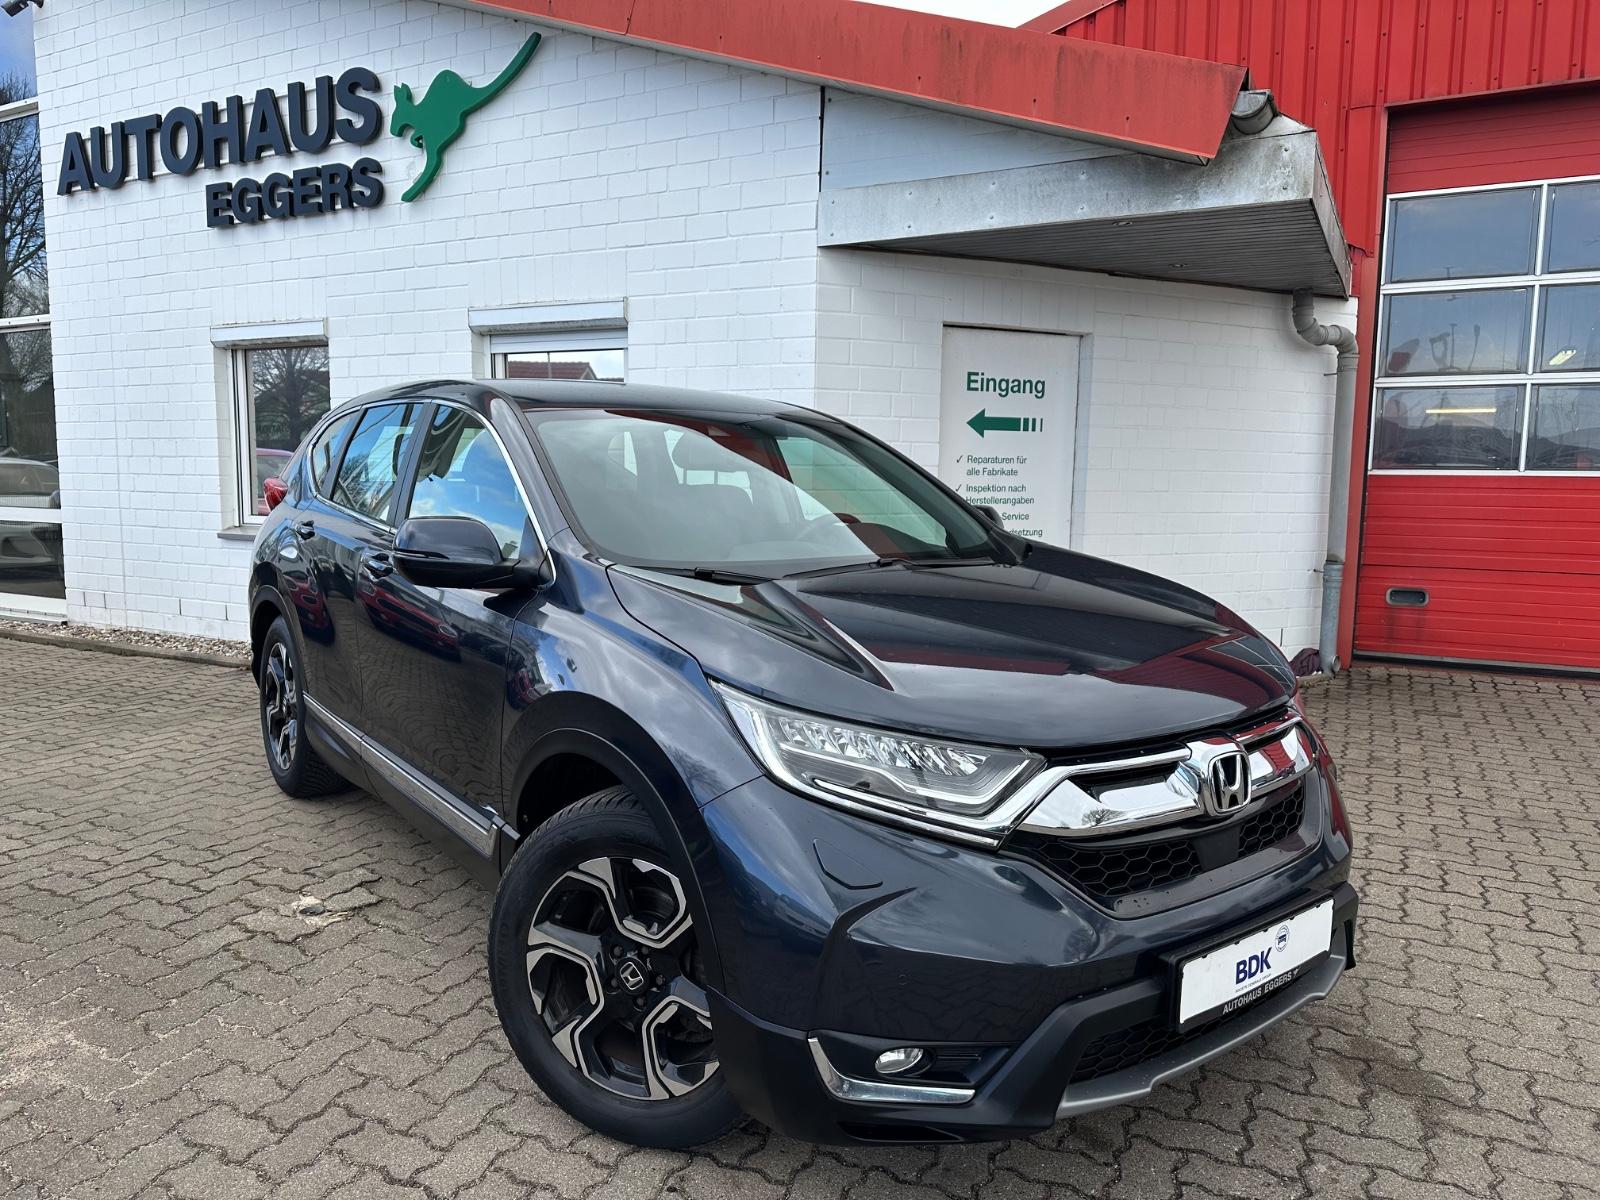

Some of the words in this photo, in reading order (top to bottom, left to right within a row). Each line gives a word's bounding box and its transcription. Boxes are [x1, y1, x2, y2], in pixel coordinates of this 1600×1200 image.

[57, 67, 383, 196] AUTOHAUS
[205, 157, 384, 228] EGGERS
[966, 372, 1045, 398] Eingang
[966, 467, 980, 476] alle
[982, 467, 1018, 476] Fabrikate
[967, 455, 1014, 465] Reparaturen
[1016, 456, 1027, 464] für
[966, 484, 1006, 493] Inspektion
[1008, 484, 1026, 492] nach
[1235, 946, 1272, 985] BDK
[1222, 987, 1262, 1015] AUTOHAUS
[1264, 971, 1292, 993] EGGERS
